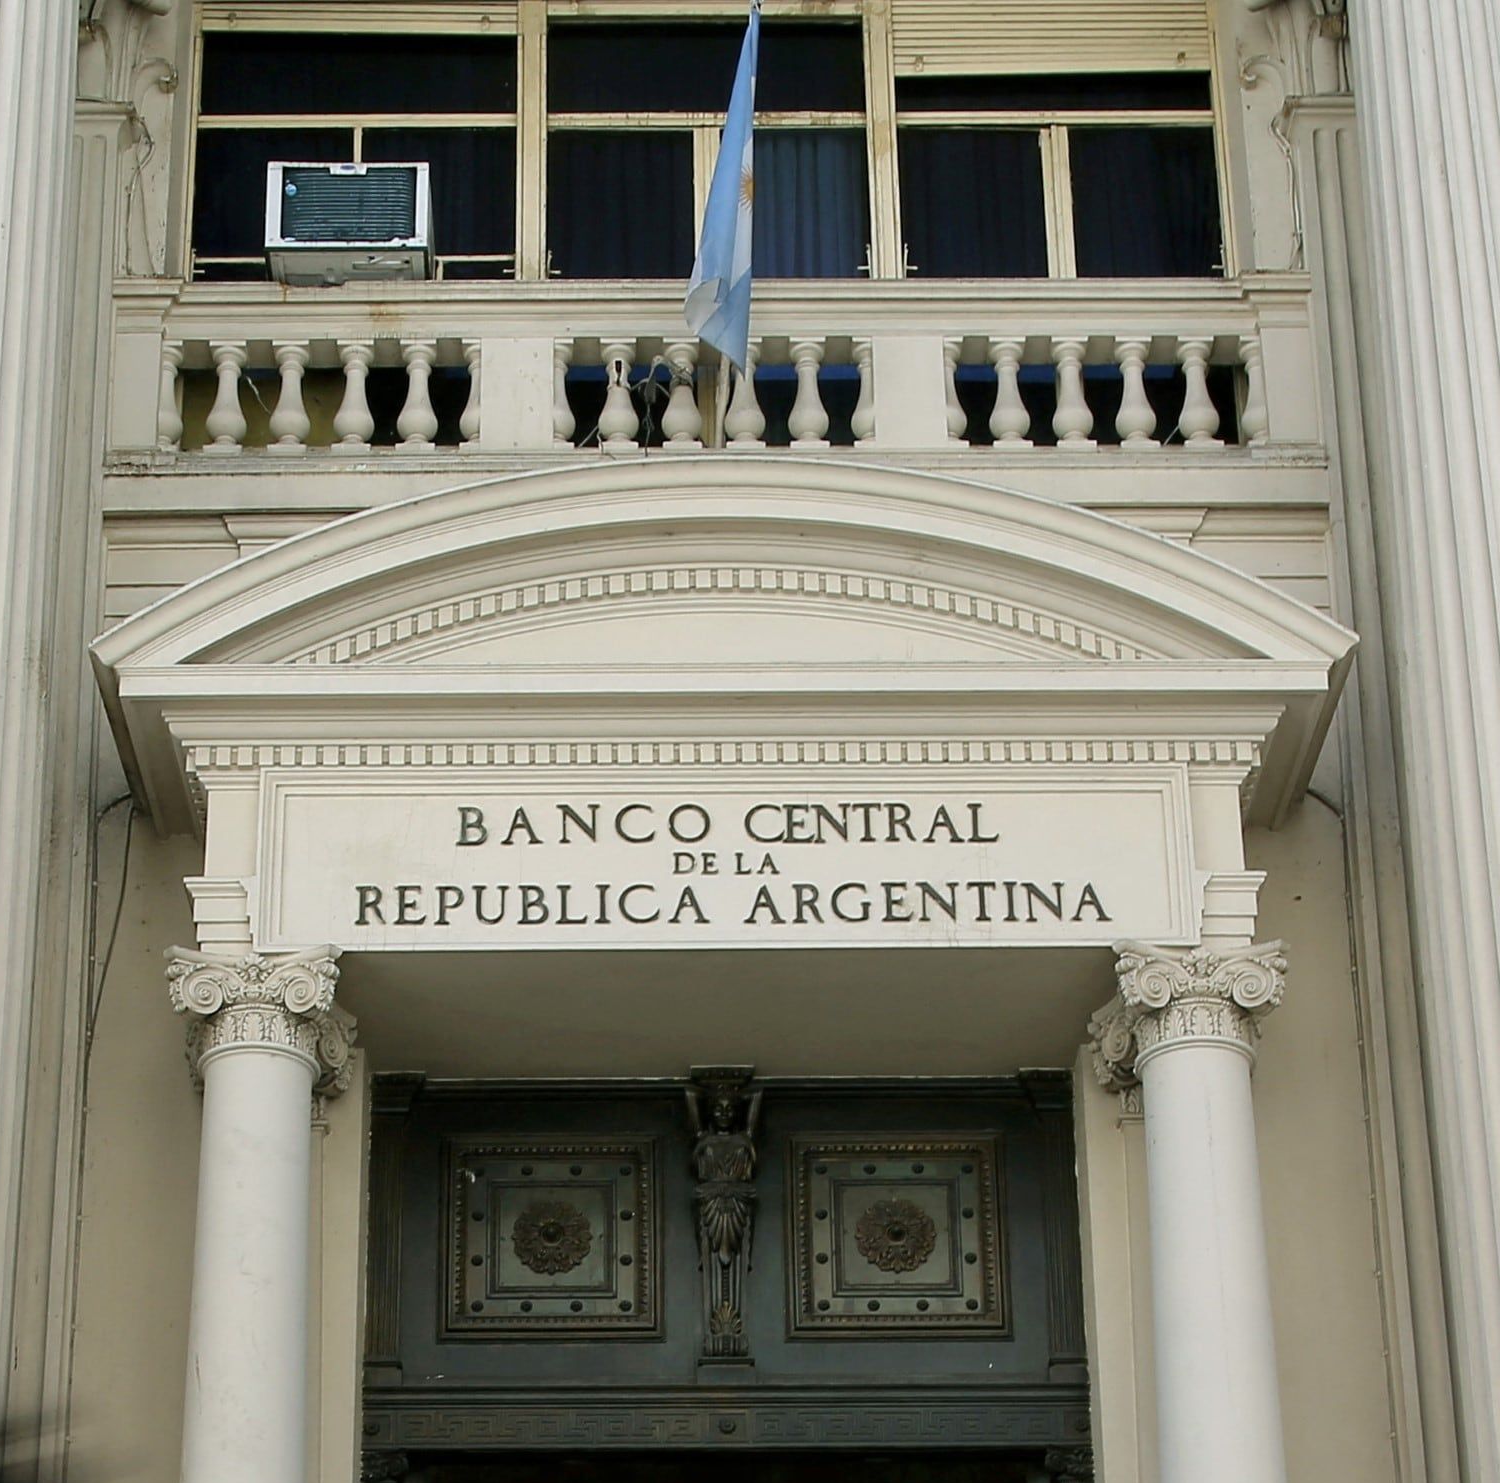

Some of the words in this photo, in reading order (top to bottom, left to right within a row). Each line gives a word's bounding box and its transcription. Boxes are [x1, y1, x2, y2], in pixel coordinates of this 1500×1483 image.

[456, 803, 711, 846] BANCO
[744, 802, 1000, 845] CENTRAL
[672, 851, 719, 875] DE
[735, 851, 780, 875] LA
[355, 884, 710, 926] REPUBLICA
[744, 881, 1112, 924] ARGENTINA
